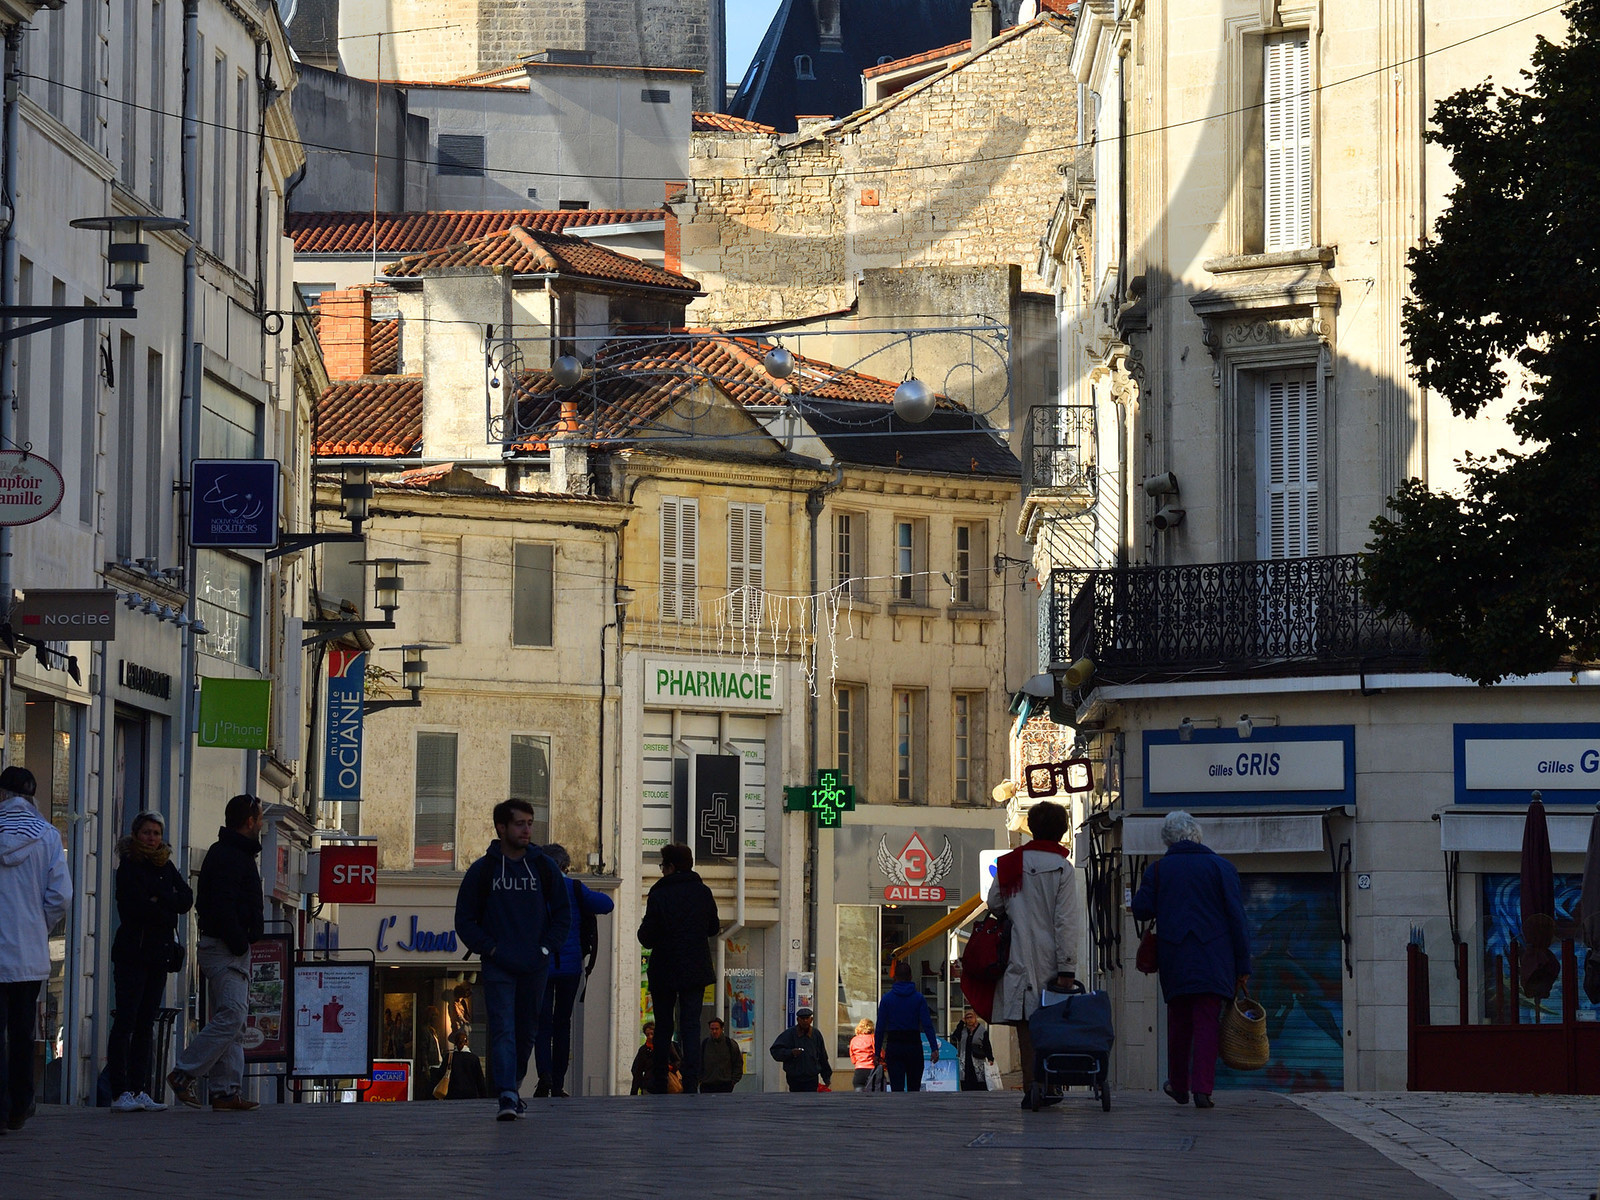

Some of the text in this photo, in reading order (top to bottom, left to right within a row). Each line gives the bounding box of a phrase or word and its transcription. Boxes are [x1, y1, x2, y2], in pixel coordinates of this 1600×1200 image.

[657, 668, 772, 700] PHARMACIE
[330, 690, 340, 756] mutuelle
[338, 691, 360, 789] OCIANE
[1209, 753, 1280, 776] Gilles GRIS
[1538, 761, 1574, 773] Gilles
[332, 864, 375, 884] SFR
[905, 849, 926, 879] 3
[492, 877, 538, 891] KULTE
[889, 887, 941, 900] AILES
